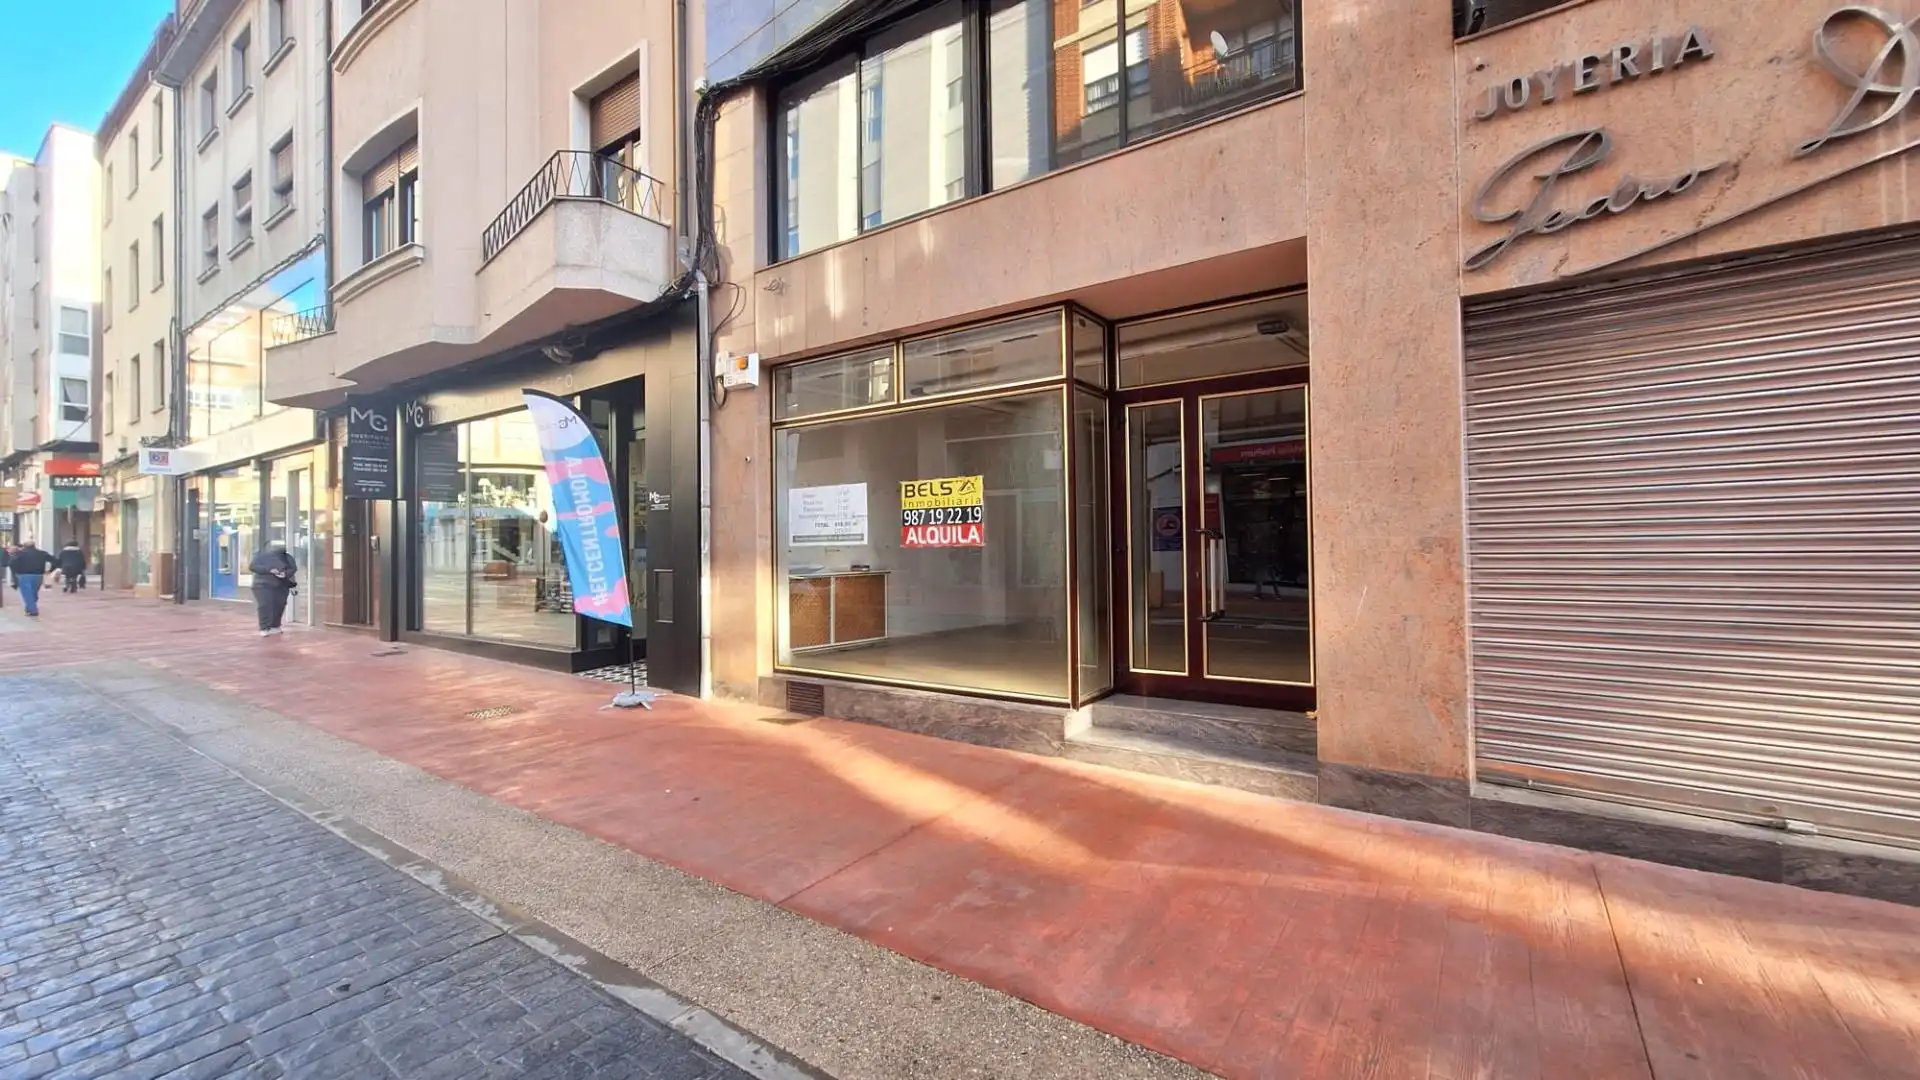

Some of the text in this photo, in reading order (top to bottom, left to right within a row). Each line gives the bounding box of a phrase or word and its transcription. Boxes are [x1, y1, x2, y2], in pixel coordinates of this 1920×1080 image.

[1475, 25, 1715, 121] JOYERIA
[350, 406, 388, 432] MG
[405, 400, 424, 428] MG
[904, 506, 982, 526] 987 19 22 19
[906, 525, 981, 545] ALQUILA
